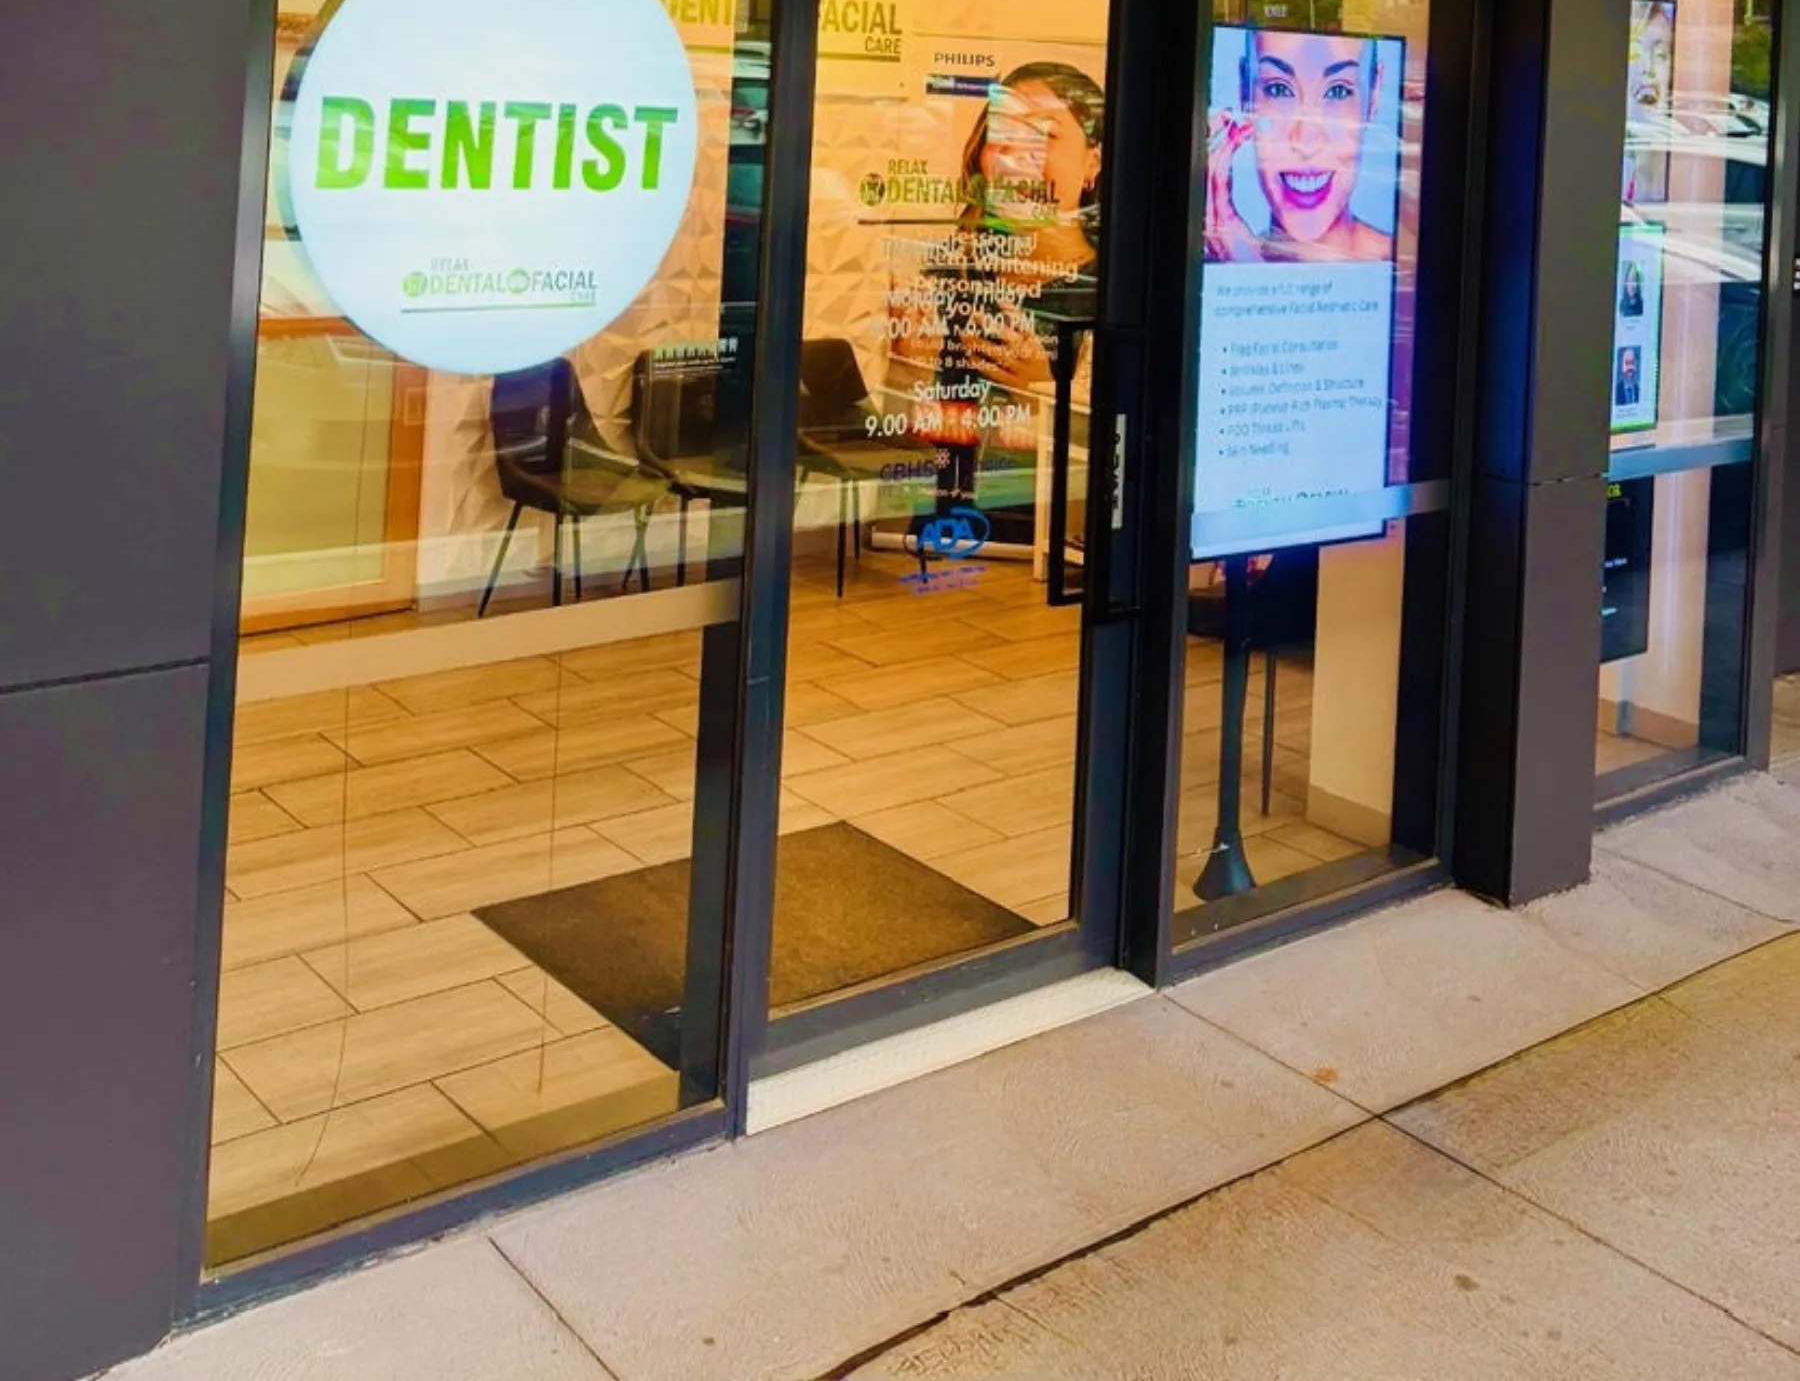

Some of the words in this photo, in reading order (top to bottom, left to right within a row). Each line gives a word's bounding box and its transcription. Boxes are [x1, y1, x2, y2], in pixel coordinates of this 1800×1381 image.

[864, 36, 901, 54] CARE
[934, 52, 996, 68] PHILIPS
[315, 96, 679, 193] DENTIST
[888, 159, 928, 175] RELAX
[886, 175, 968, 205] DENTAL
[430, 272, 508, 295] DENTAL
[533, 269, 599, 293] FACIAL
[913, 375, 992, 403] Saturday
[865, 413, 907, 438] 9.00
[912, 409, 943, 434] AM
[1004, 403, 1031, 426] PM
[918, 519, 974, 553] ADA
